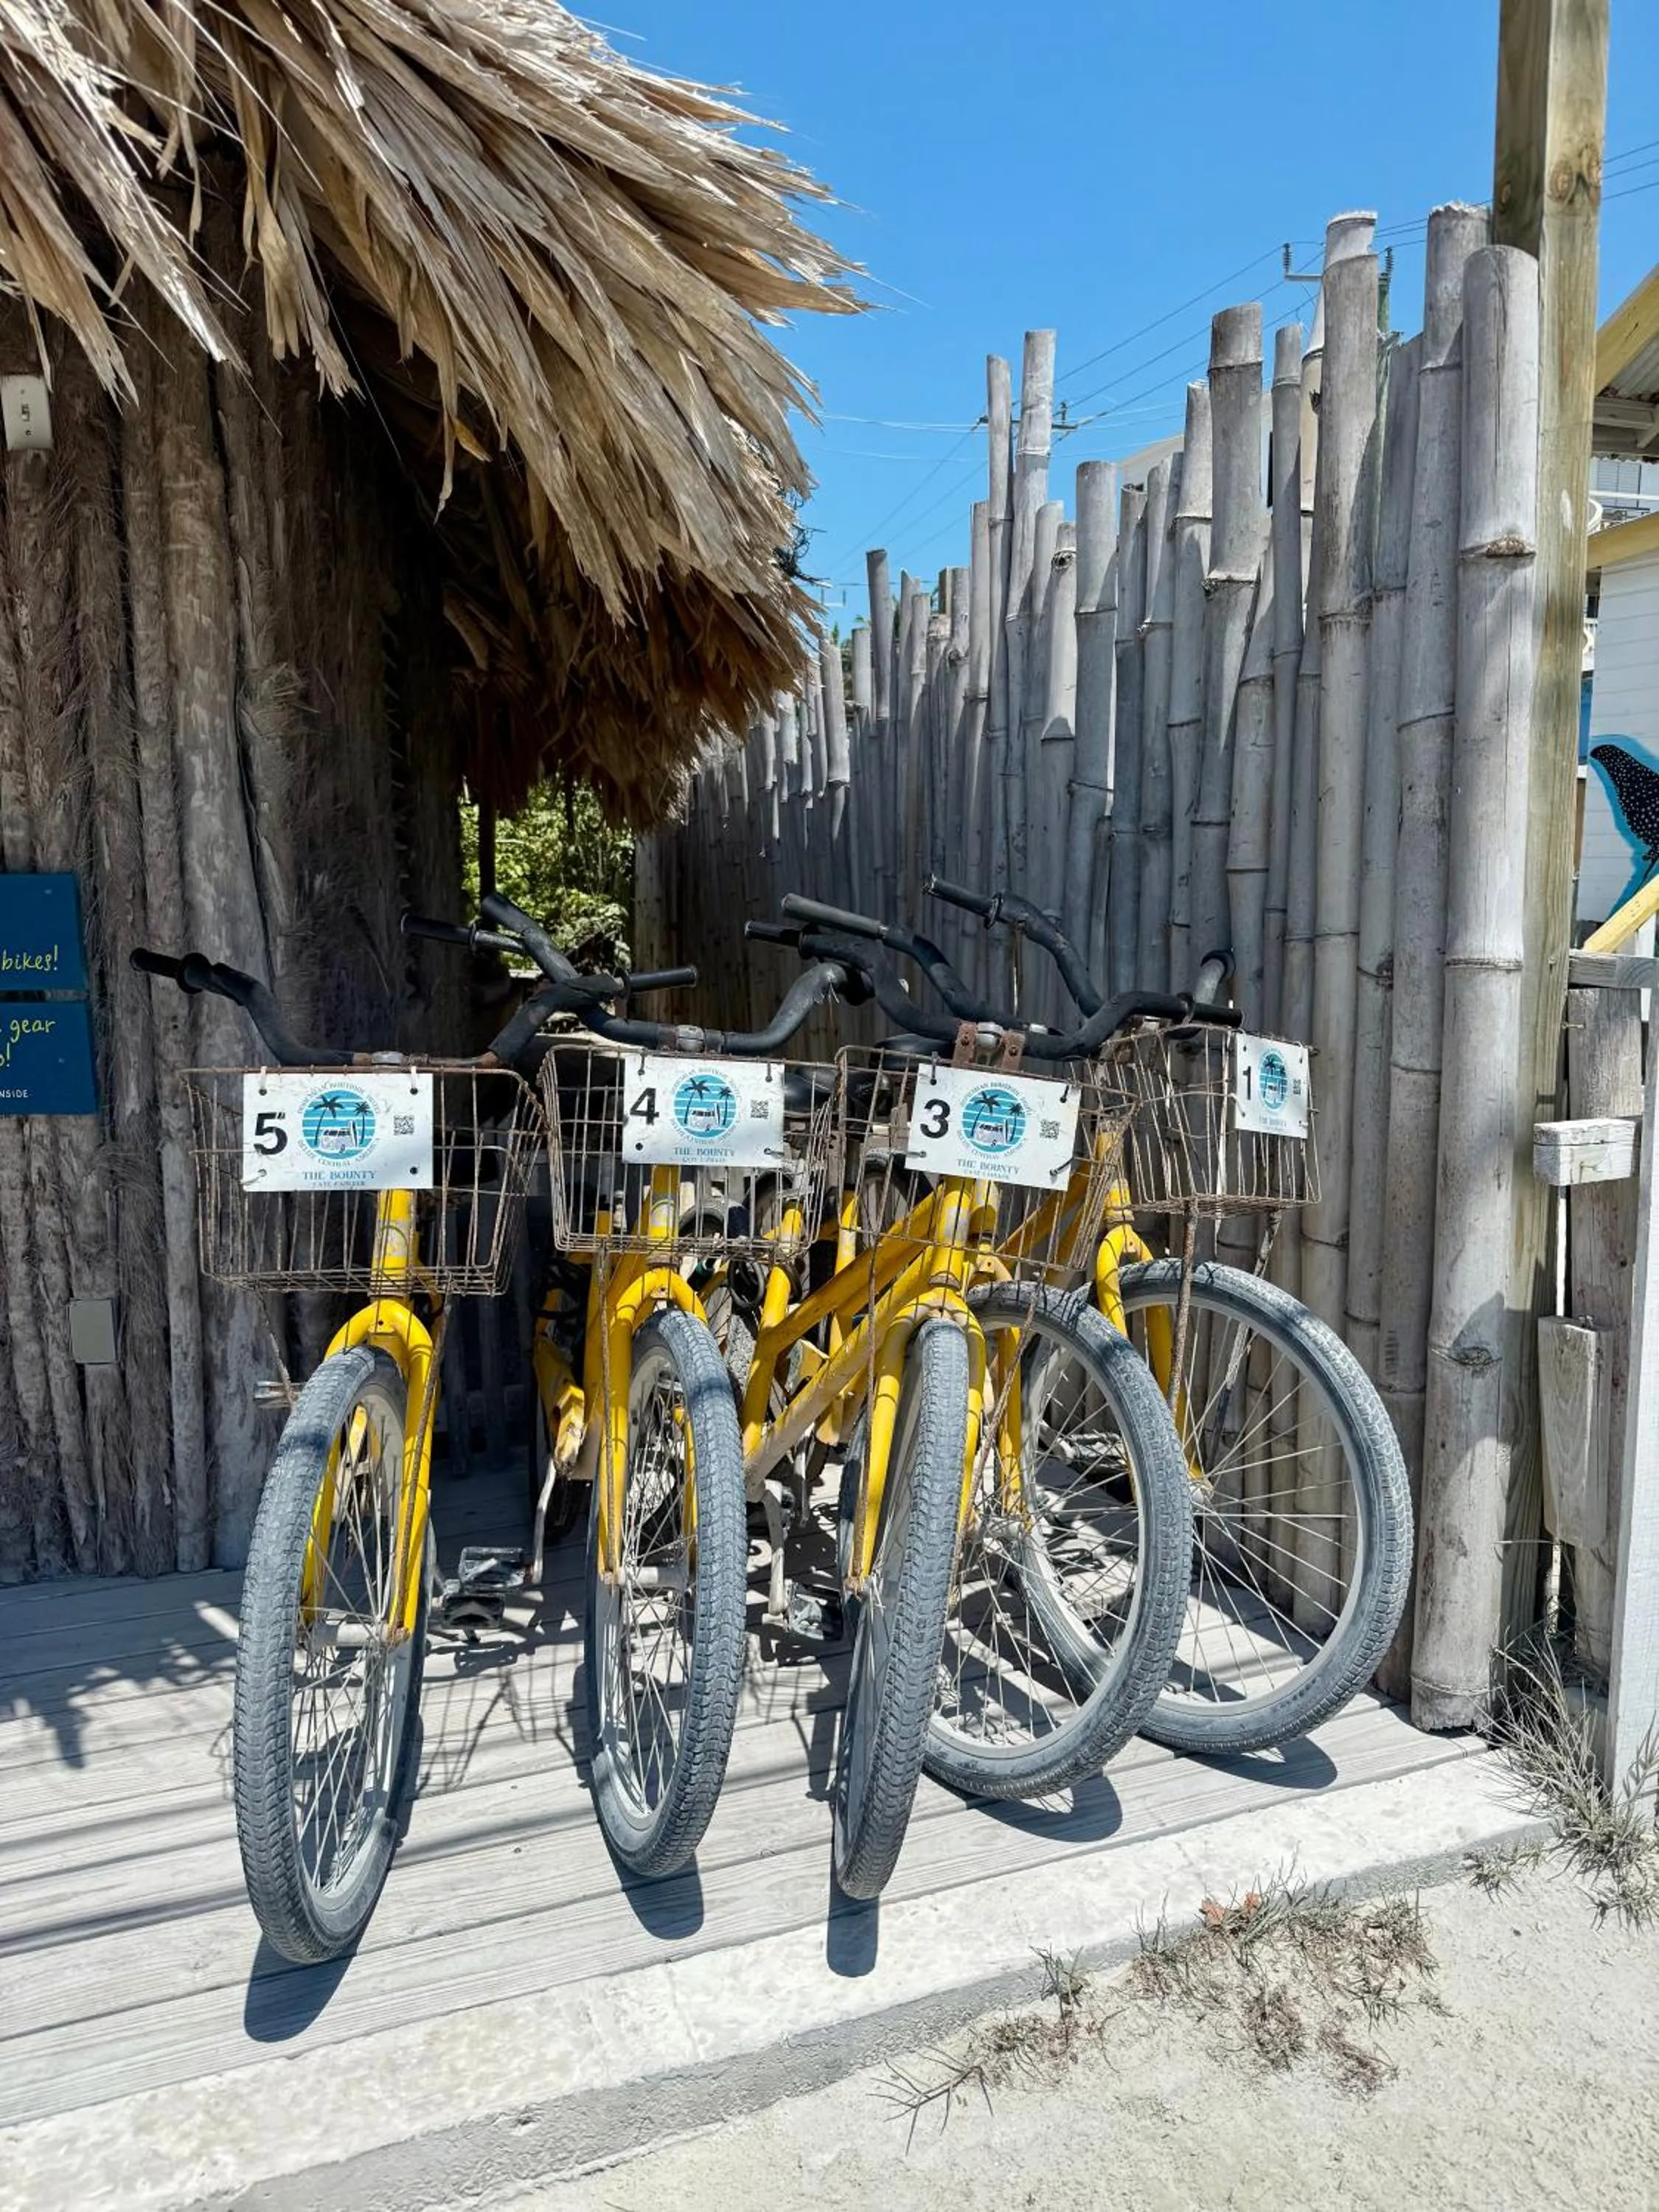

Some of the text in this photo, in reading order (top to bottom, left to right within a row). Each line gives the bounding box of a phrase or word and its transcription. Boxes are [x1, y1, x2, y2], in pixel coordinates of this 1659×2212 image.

[1, 944, 58, 971] bikes!
[10, 1020, 56, 1043] gear
[1242, 1065, 1251, 1100] 1
[630, 1088, 659, 1125] 4
[920, 1099, 950, 1138] 3
[254, 1111, 288, 1155] 5
[672, 1147, 735, 1157] THE BOUNTY
[302, 1169, 378, 1180] THE BOUNTY
[956, 1158, 977, 1169] THE
[981, 1161, 1020, 1175] BOUNTY
